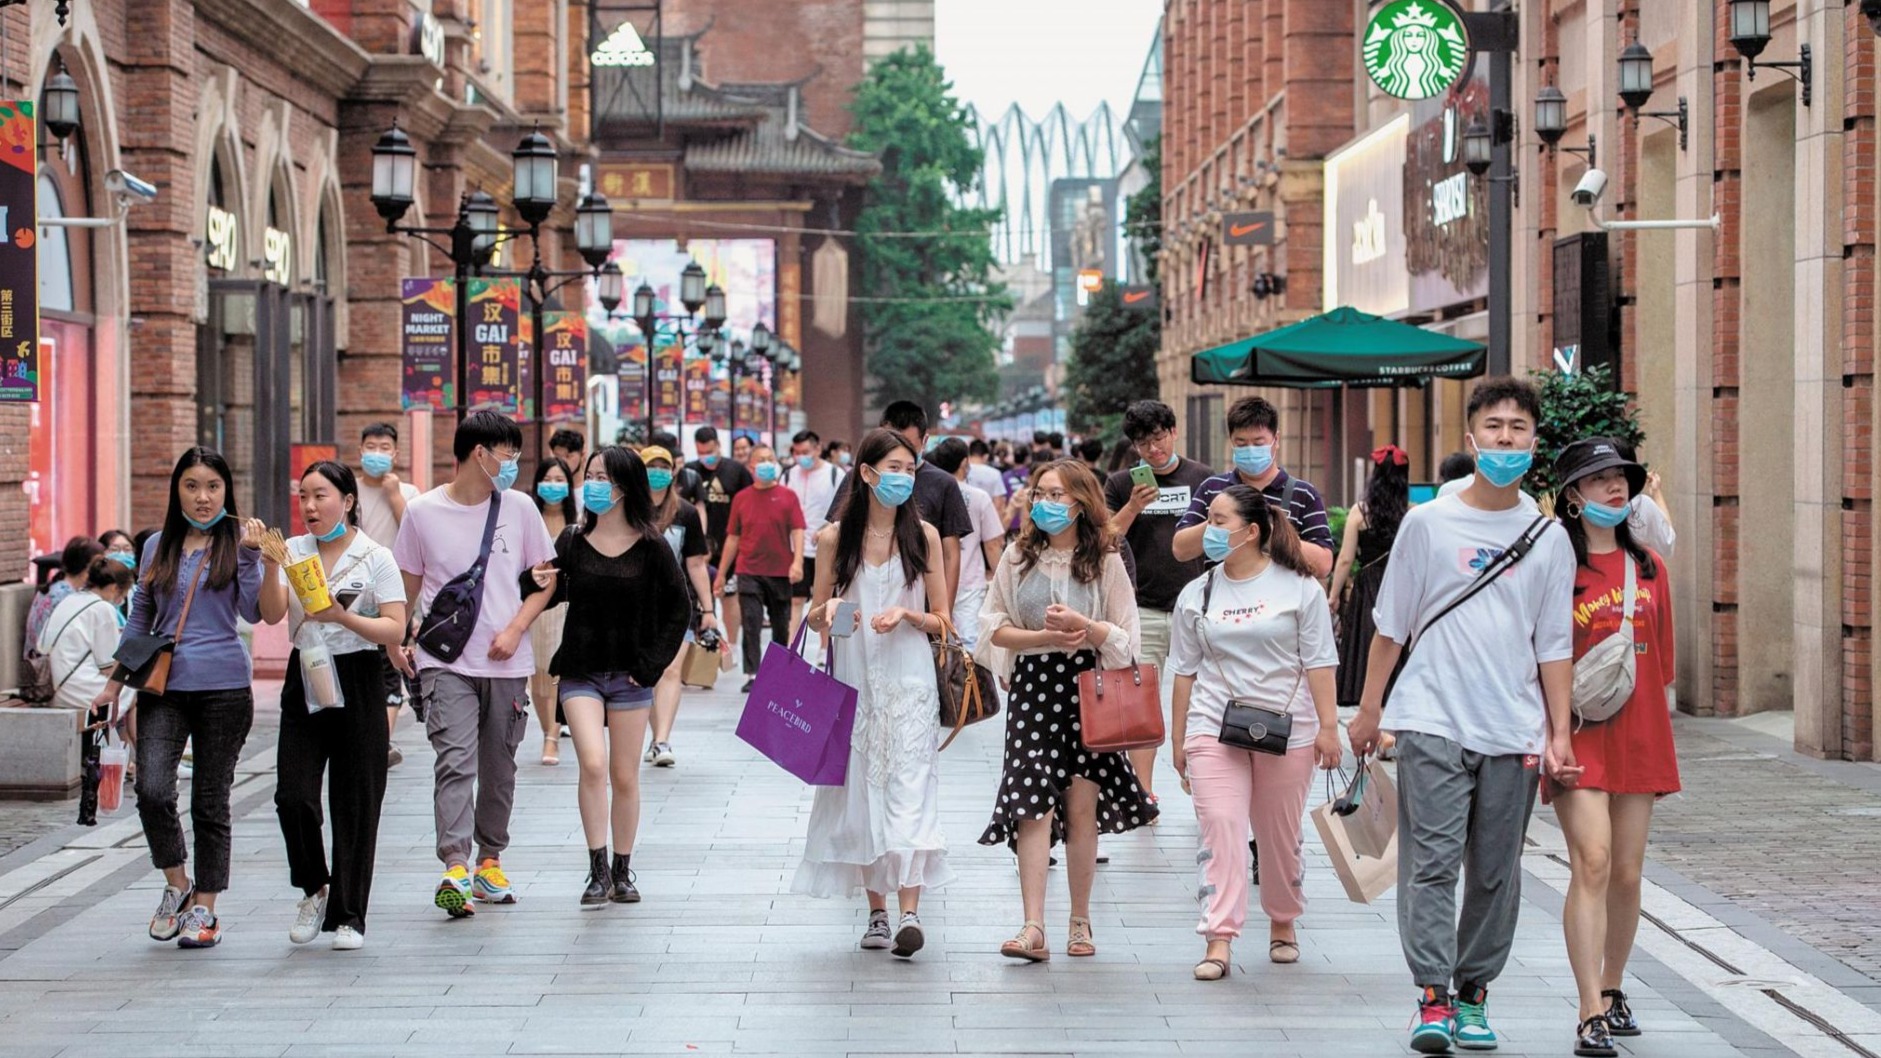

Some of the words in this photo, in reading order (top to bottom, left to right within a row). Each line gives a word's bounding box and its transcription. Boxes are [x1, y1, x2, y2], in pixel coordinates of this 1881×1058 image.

[411, 313, 444, 323] NIGHT
[484, 303, 502, 322] 汉
[405, 324, 449, 334] MARKET
[475, 324, 508, 343] GAI
[550, 350, 577, 366] GAI
[1379, 364, 1434, 375] STARBUCKS
[1435, 362, 1472, 372] COFFEE
[1158, 492, 1187, 503] ORT
[1223, 606, 1259, 616] CHERRY
[1573, 593, 1611, 628] Money
[767, 700, 812, 734] PEACEBIRD
